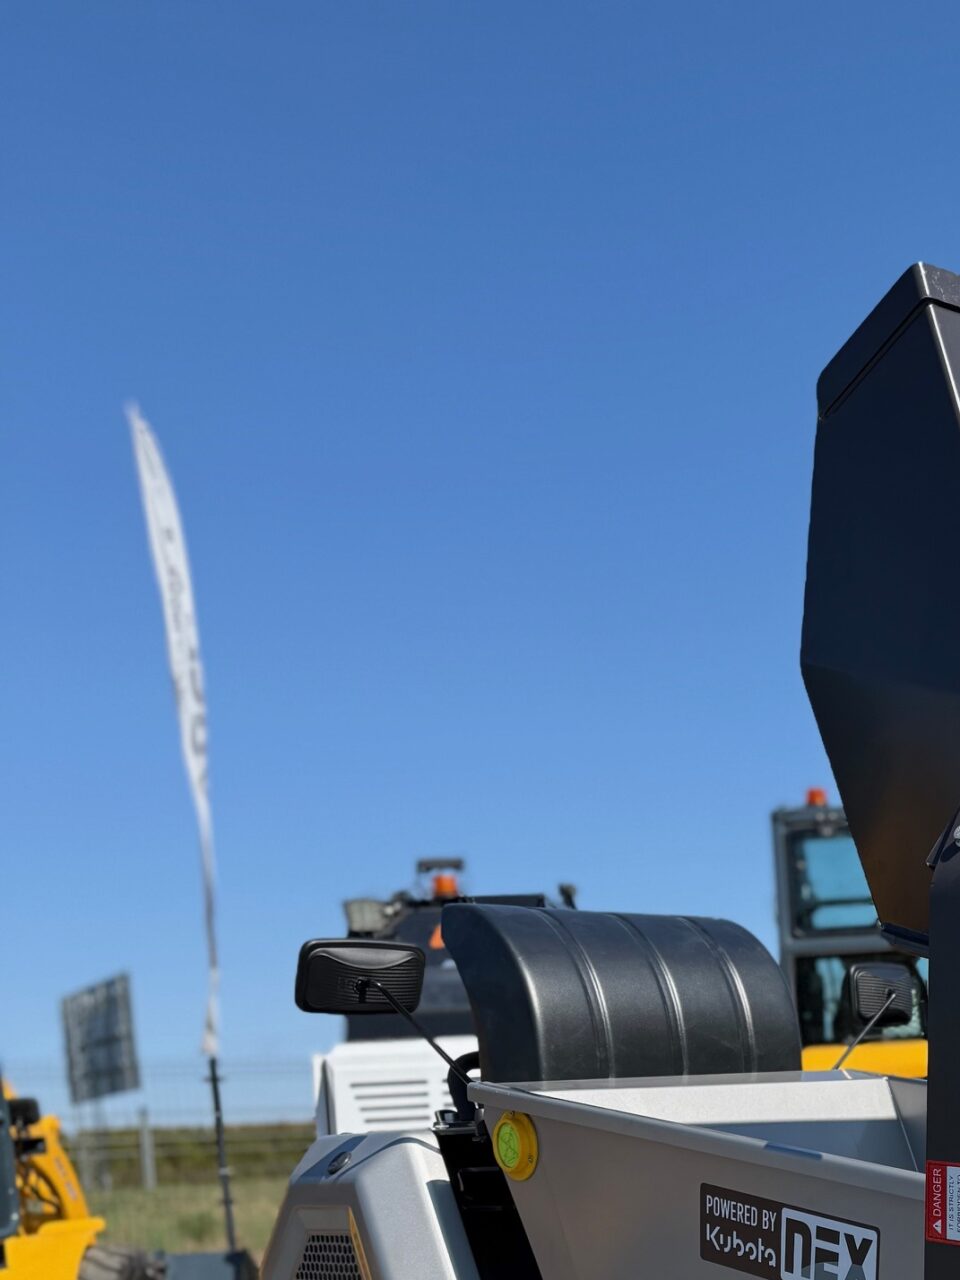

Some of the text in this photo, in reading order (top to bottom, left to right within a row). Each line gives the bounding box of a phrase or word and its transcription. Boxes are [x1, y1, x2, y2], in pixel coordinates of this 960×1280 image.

[706, 1194, 777, 1232] POWERED BY
[933, 1168, 942, 1217] DANGER
[949, 1214, 954, 1222] IS
[706, 1223, 776, 1268] Kubota
